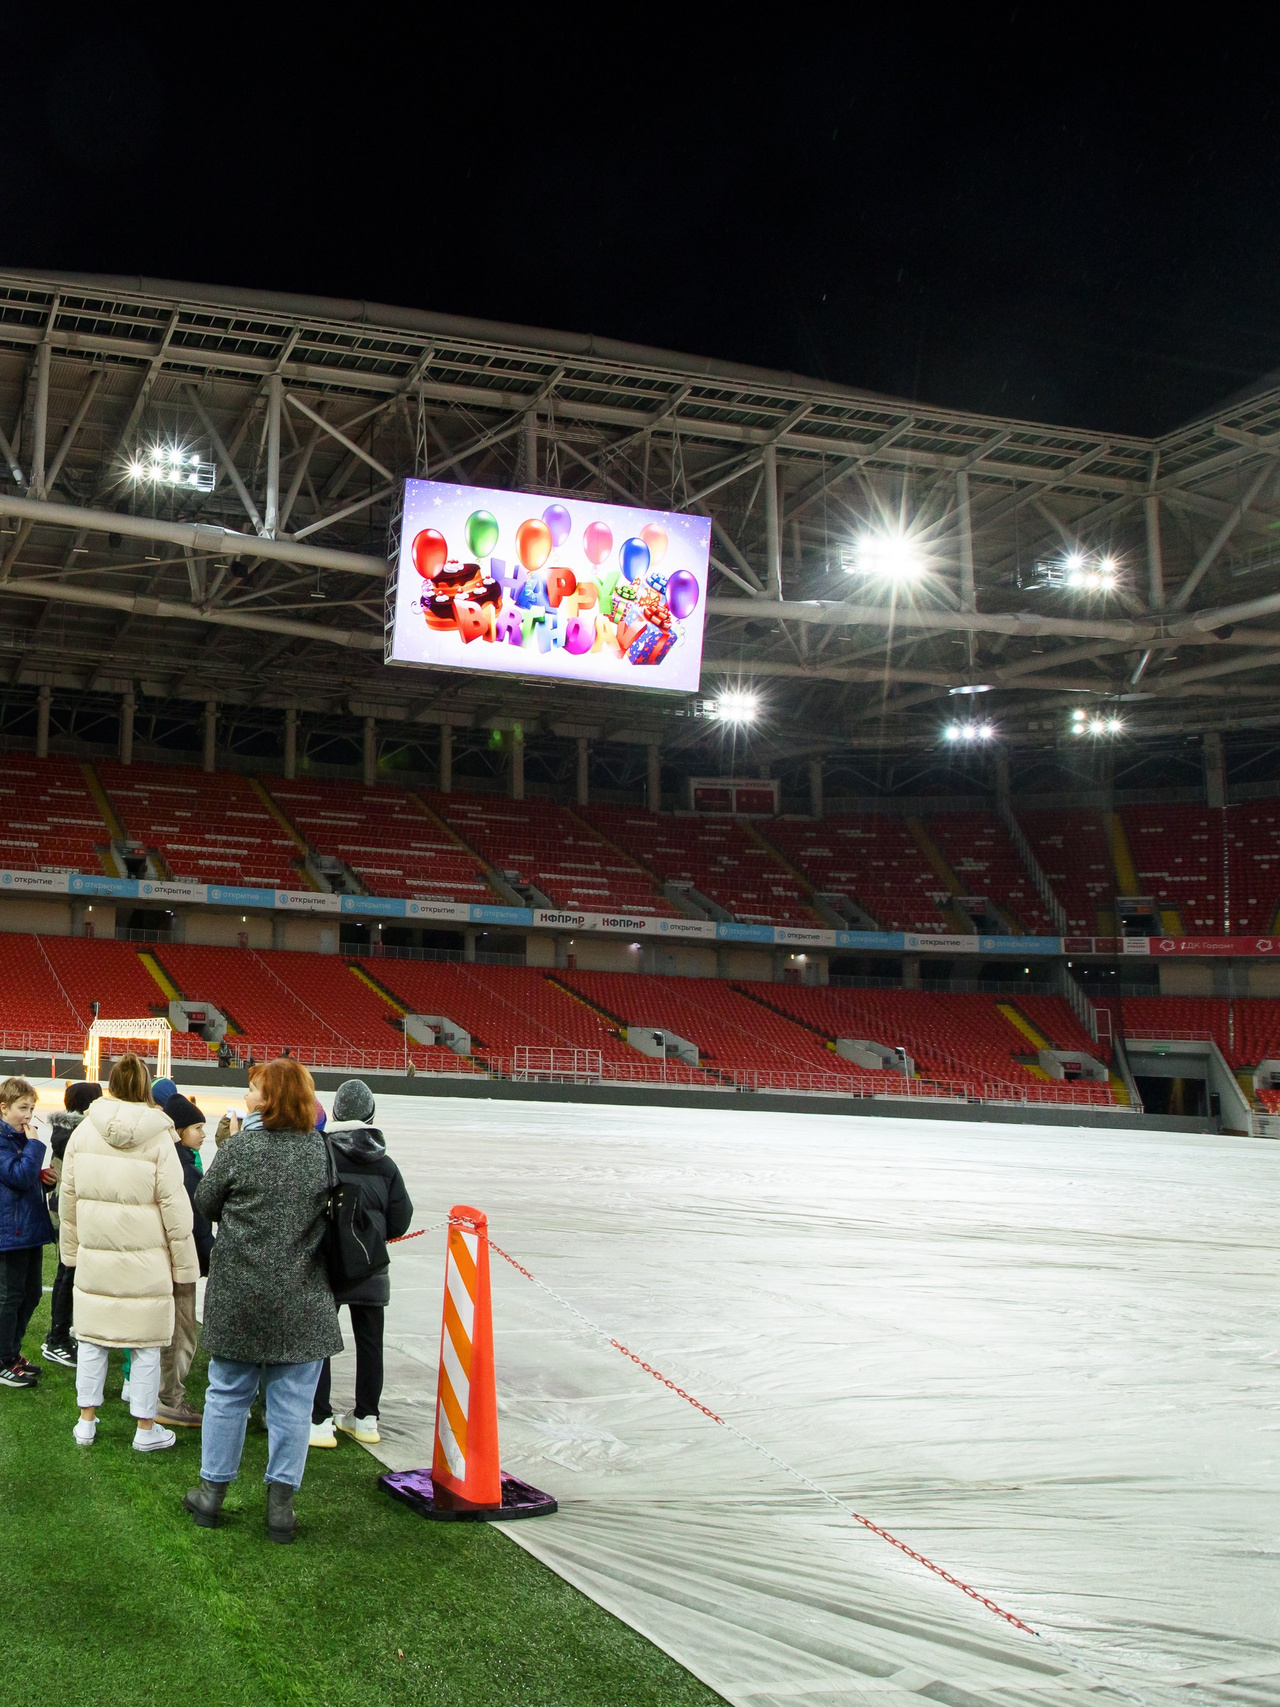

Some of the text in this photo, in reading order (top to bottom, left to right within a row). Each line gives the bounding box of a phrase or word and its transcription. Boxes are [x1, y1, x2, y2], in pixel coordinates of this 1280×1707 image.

[491, 557, 621, 617] HAPPY
[453, 598, 648, 659] BIRTHDAY
[14, 877, 53, 885] открытие
[154, 886, 192, 895] открытие
[290, 896, 326, 905] открытие
[420, 905, 455, 914] открытие
[669, 924, 703, 932] открытие
[787, 932, 820, 940] открытие
[920, 939, 961, 947] открытие
